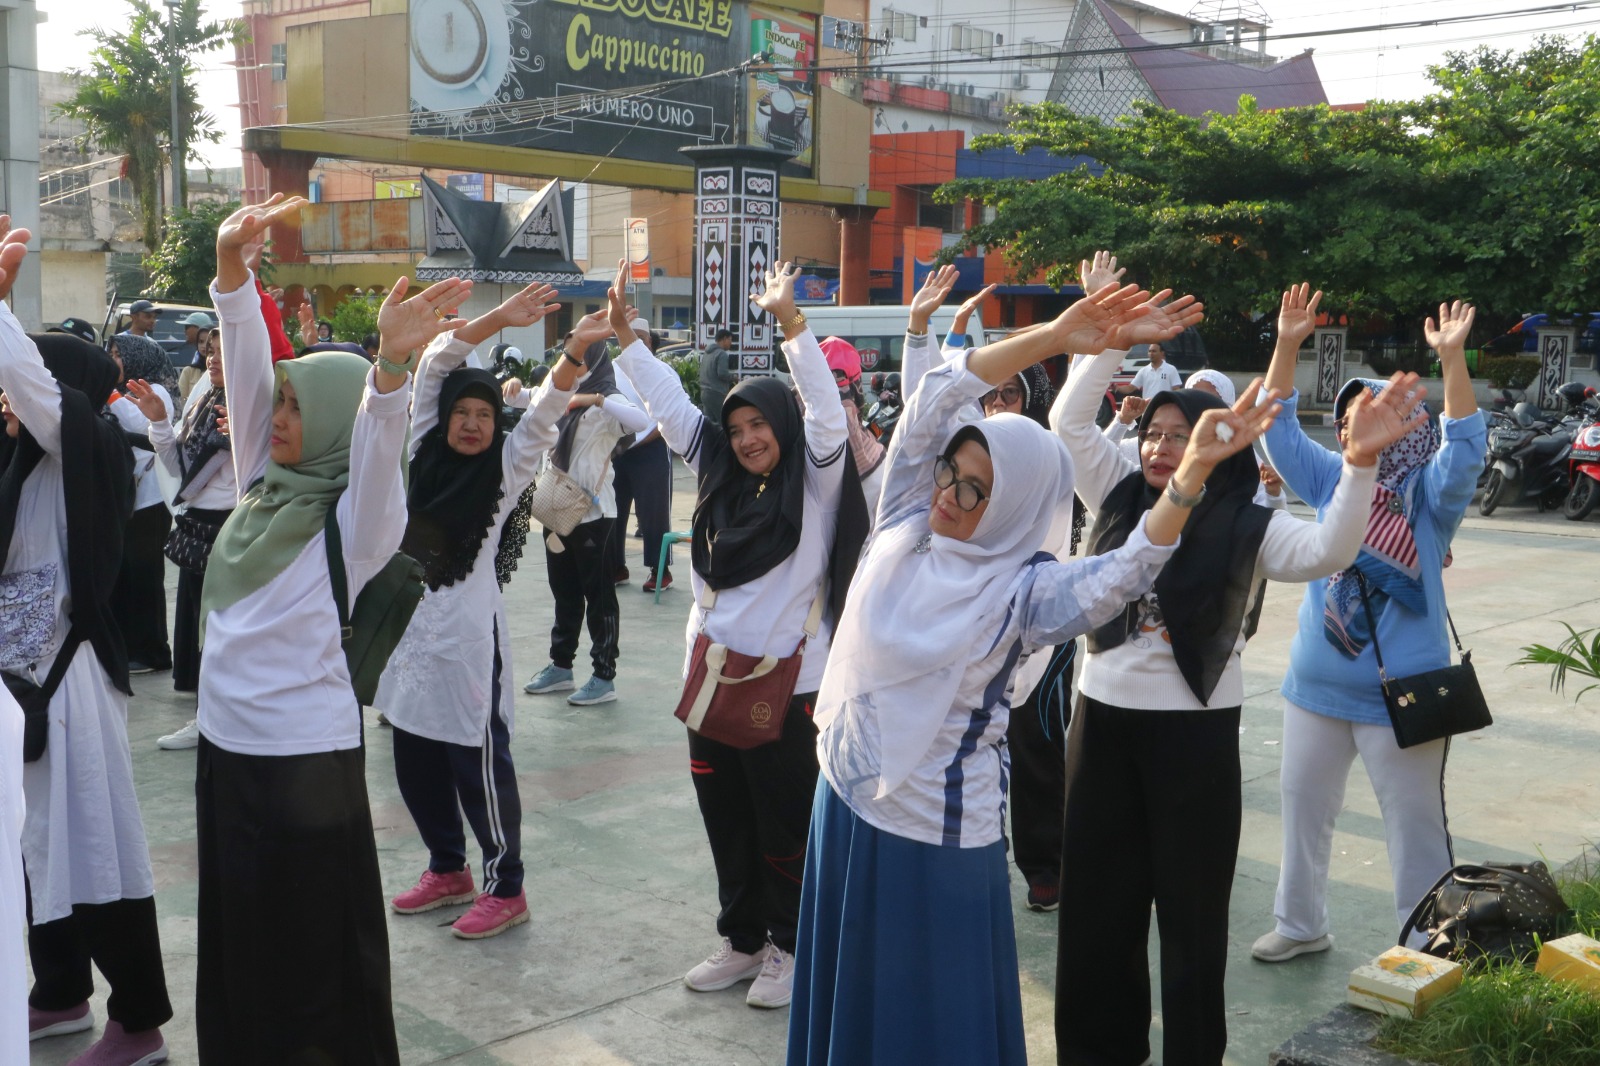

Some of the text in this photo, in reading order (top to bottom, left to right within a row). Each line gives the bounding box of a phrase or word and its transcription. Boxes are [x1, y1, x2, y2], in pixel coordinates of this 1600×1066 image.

[566, 13, 704, 77] Cappuccino
[580, 94, 694, 127] NUMERO UNO
